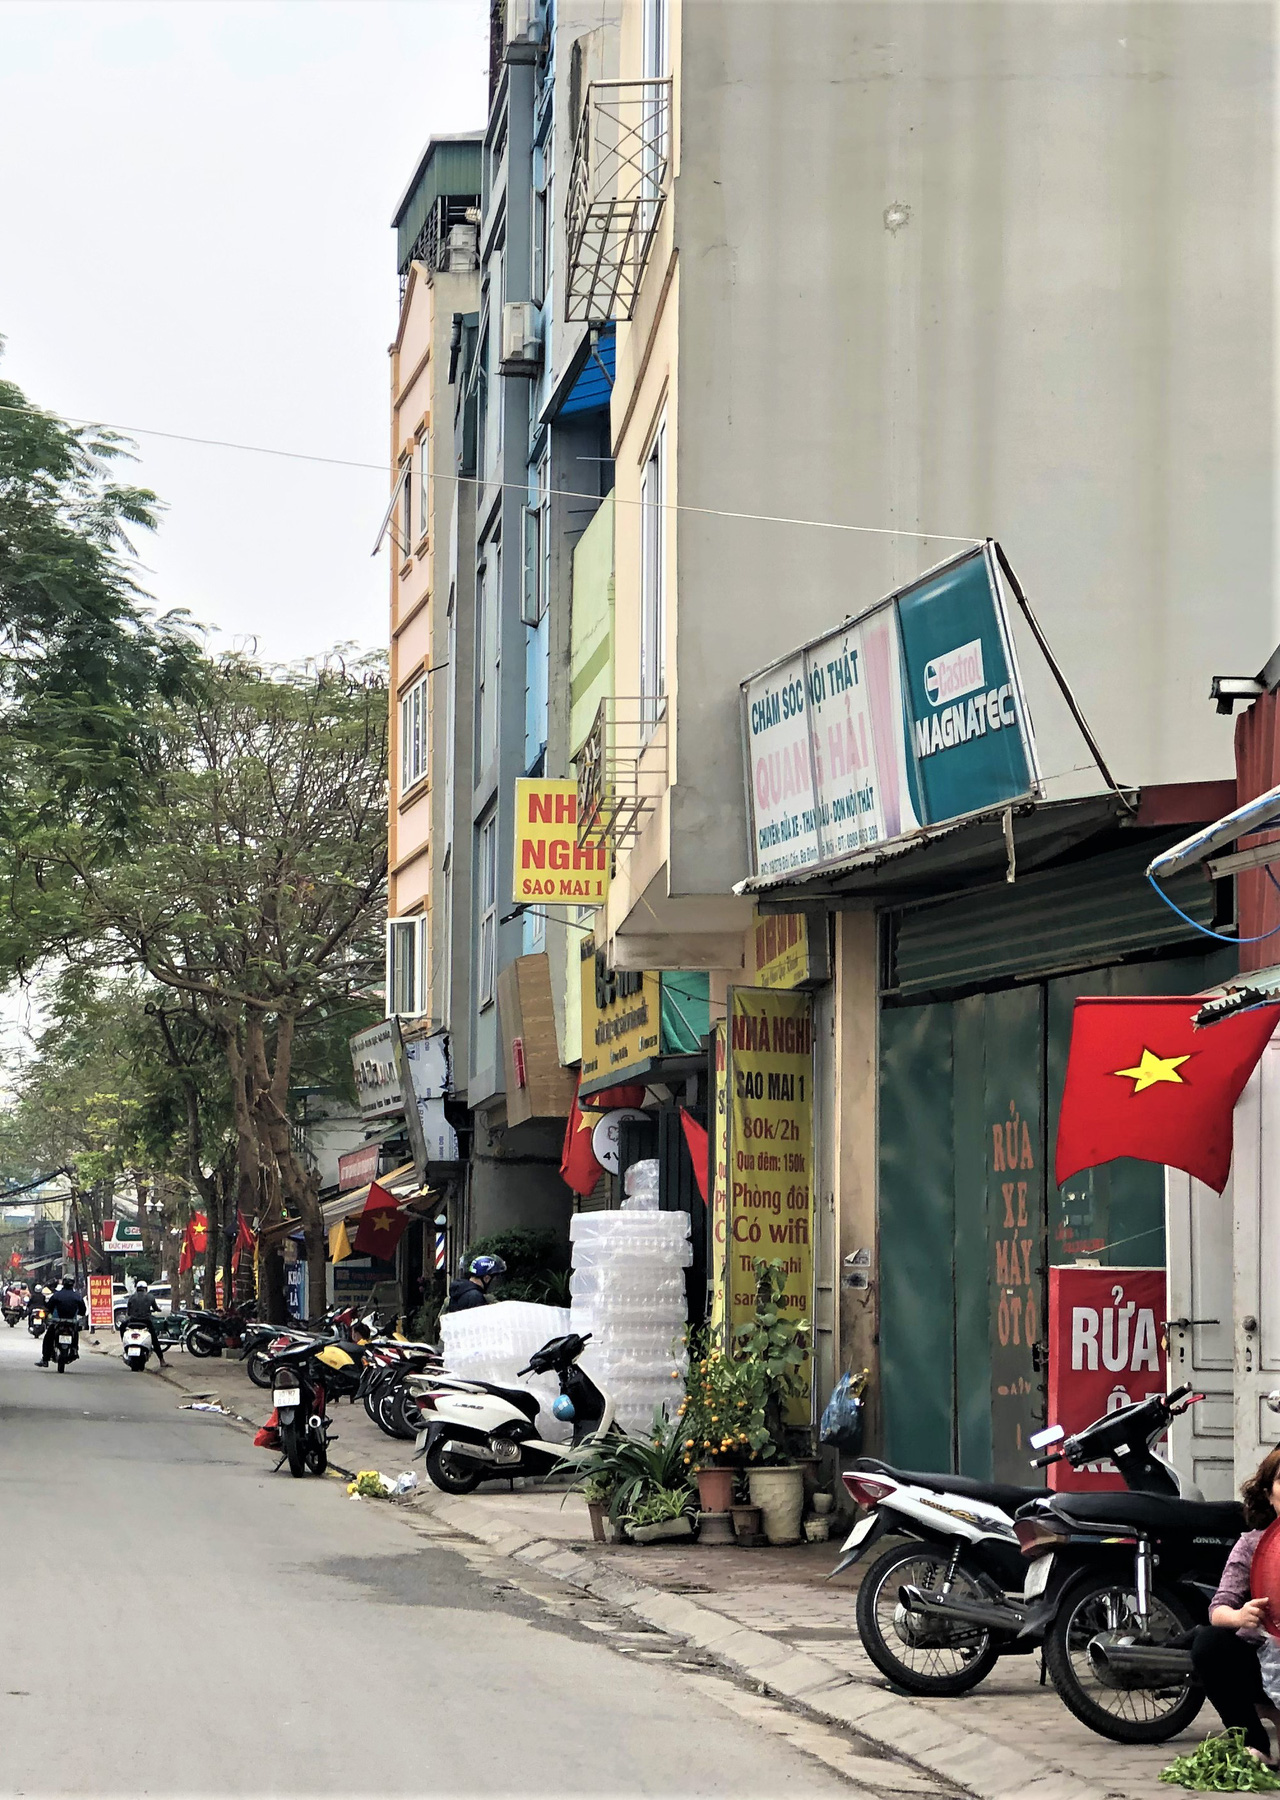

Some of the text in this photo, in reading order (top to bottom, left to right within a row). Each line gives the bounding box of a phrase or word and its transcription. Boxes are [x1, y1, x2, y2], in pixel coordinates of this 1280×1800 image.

[751, 687, 781, 735] CHĂM
[782, 673, 804, 720] SÓC
[827, 638, 859, 697] THẤT
[937, 648, 982, 697] Castrol
[827, 693, 869, 780] HẢI
[915, 684, 1016, 759] MAGNATEC
[857, 777, 875, 814] THẤT
[522, 878, 604, 896] SAO MAI 1
[732, 1005, 812, 1055] NHÀ NGHỈ
[736, 1071, 805, 1102] SAO MAI 1
[743, 1118, 800, 1142] 80k/2h
[993, 1100, 1034, 1172] RỬA
[736, 1149, 805, 1173] Qua đêm: 150k
[733, 1182, 809, 1216] Phòng đôi
[1001, 1181, 1028, 1228] XE
[733, 1216, 809, 1244] Có wifi
[739, 1255, 802, 1275] Tin ghi
[995, 1228, 1033, 1286] MÁY
[1072, 1285, 1160, 1372] RỬA
